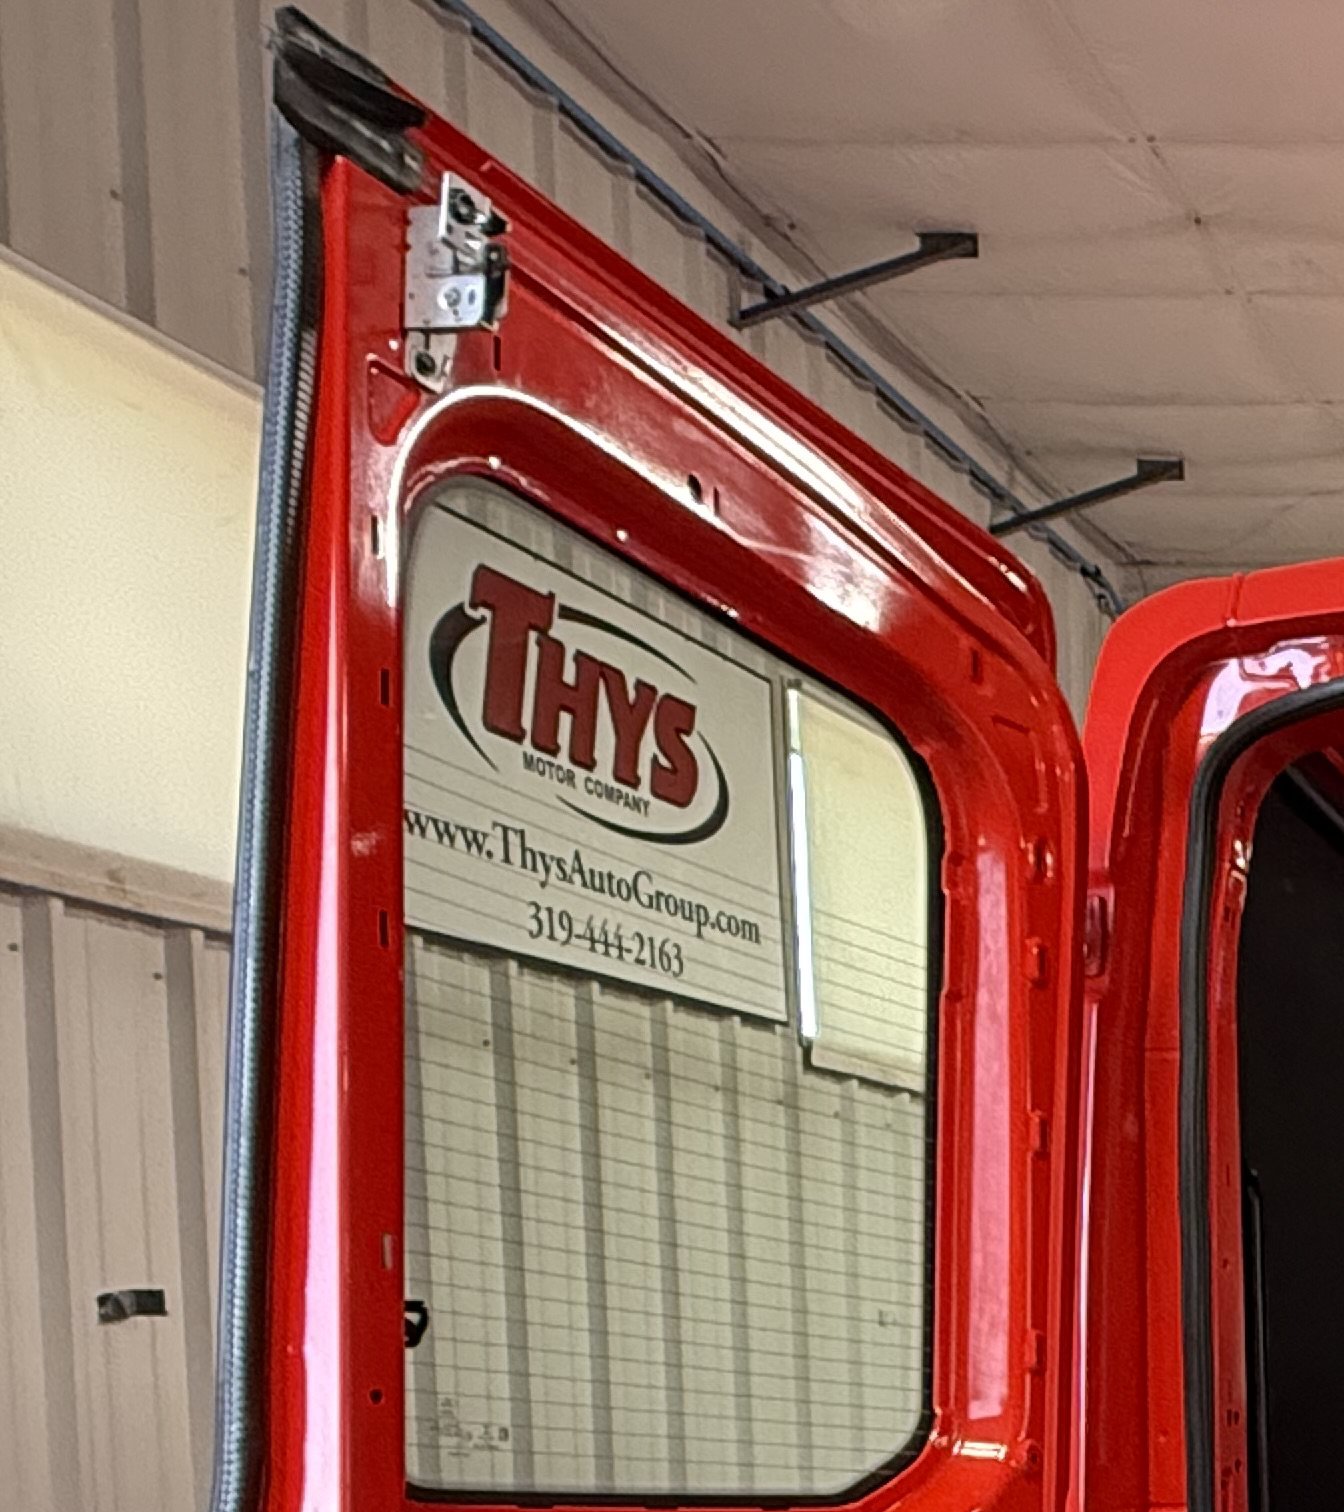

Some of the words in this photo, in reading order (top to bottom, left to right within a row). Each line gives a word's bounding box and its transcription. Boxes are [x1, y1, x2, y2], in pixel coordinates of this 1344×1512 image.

[522, 751, 577, 789] MOTOR
[584, 776, 650, 818] COMPANY
[404, 808, 762, 945] www.ThysAutoGroup.com
[527, 901, 685, 978] 319-444-2163
